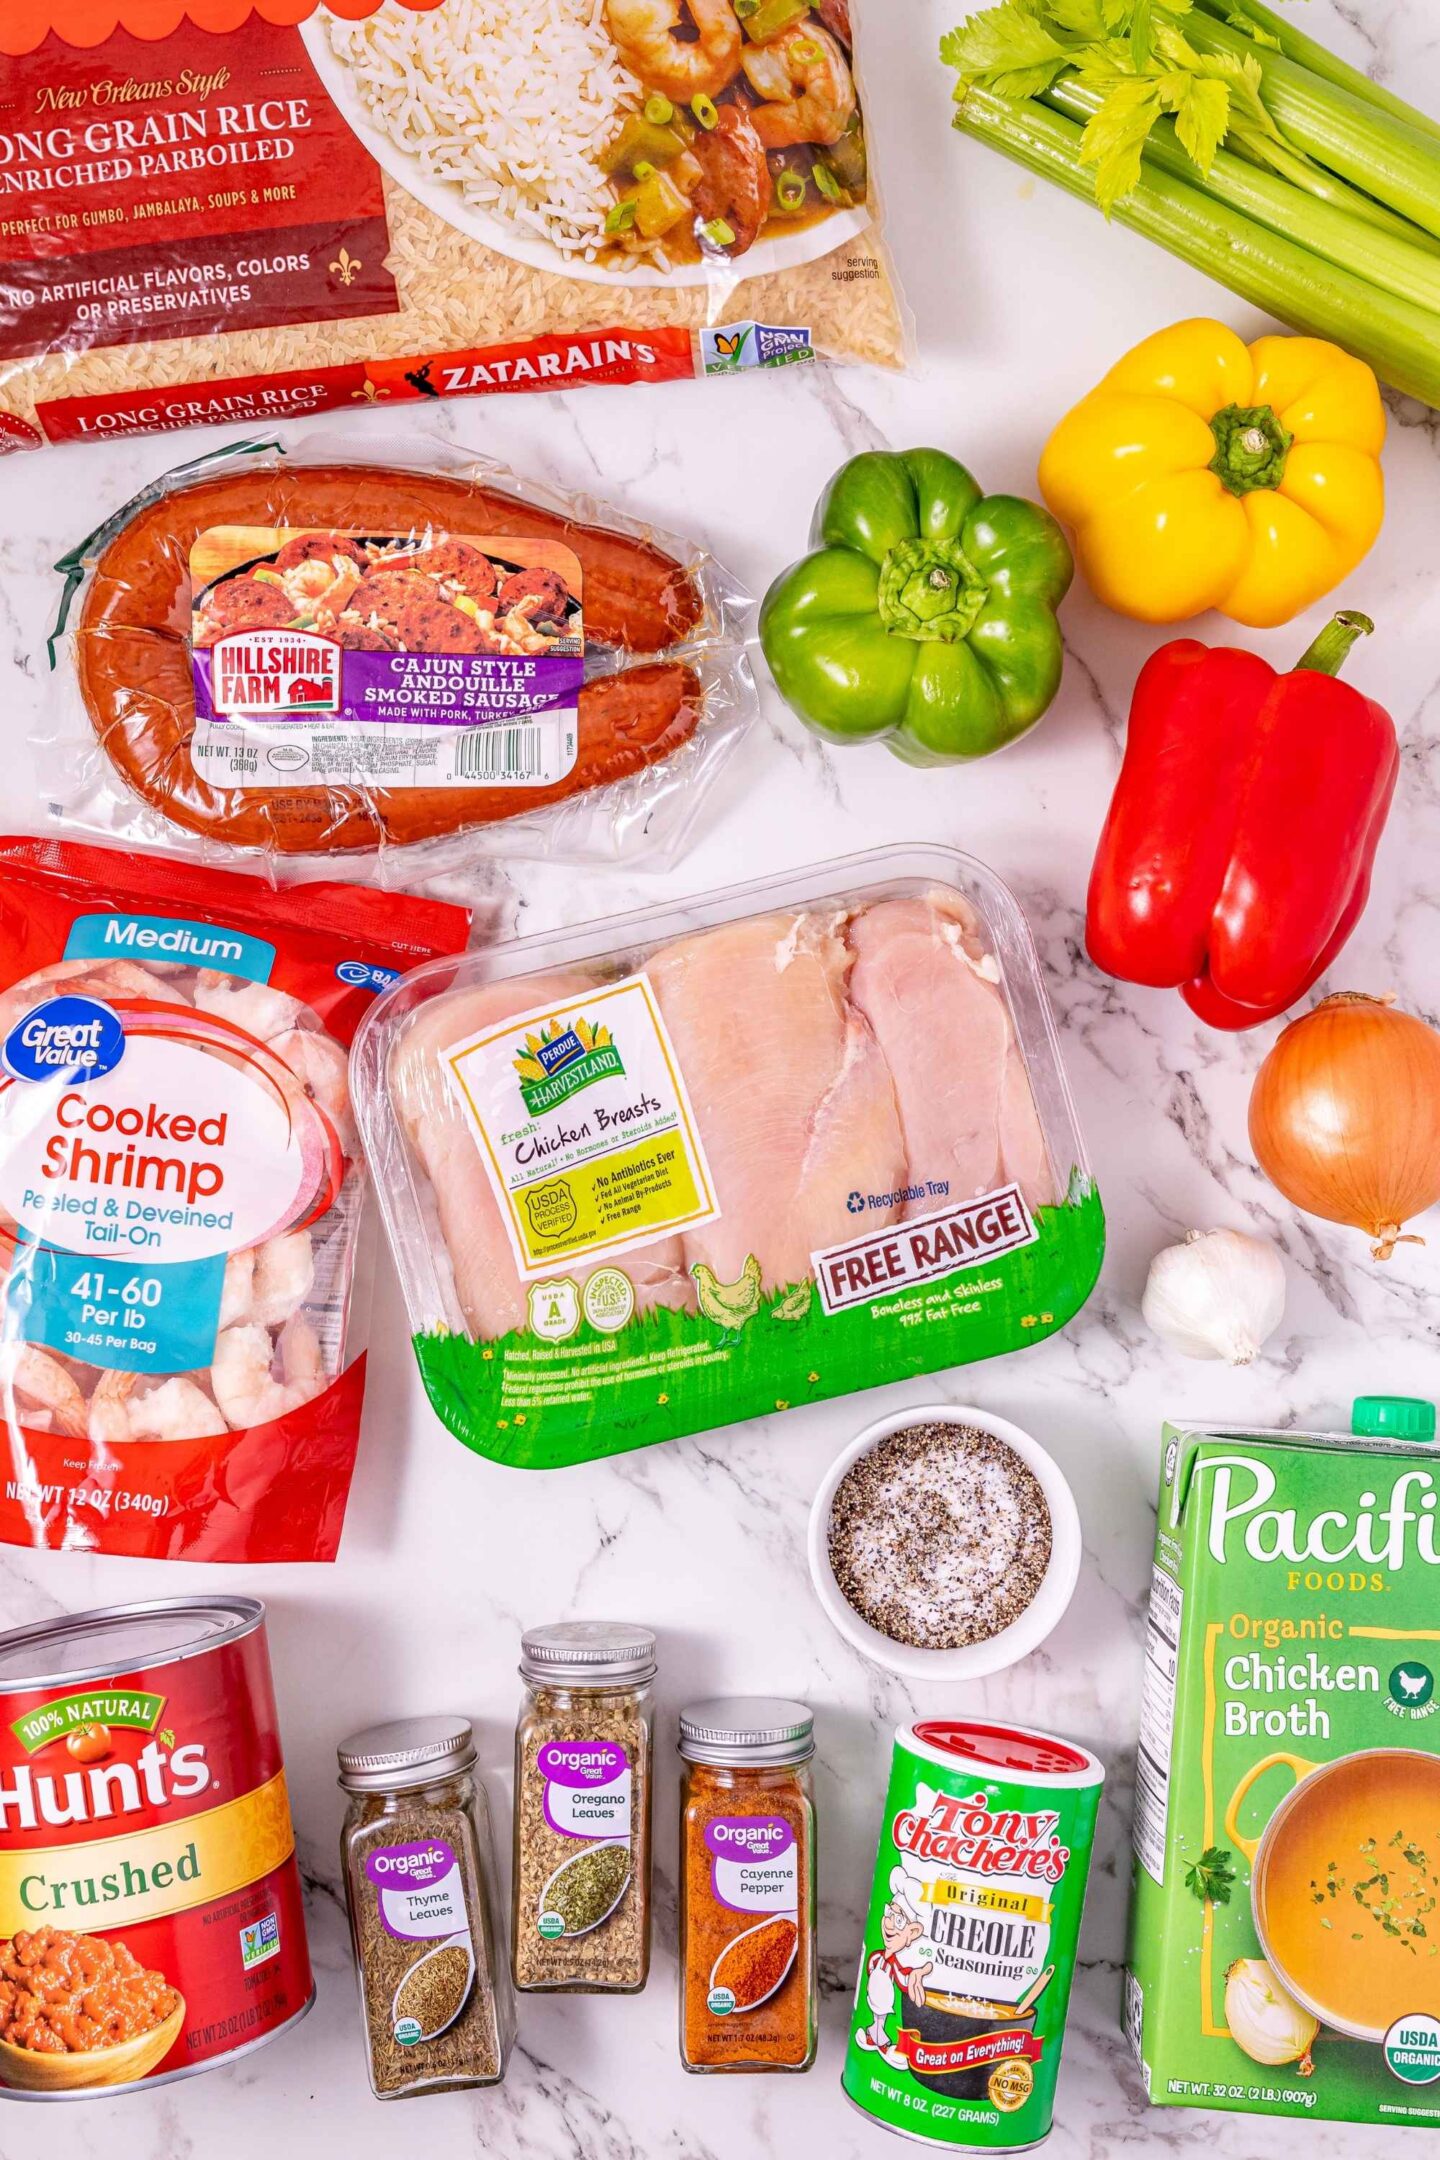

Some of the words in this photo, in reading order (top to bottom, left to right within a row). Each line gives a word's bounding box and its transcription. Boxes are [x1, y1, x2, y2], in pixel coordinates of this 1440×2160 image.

[35, 87, 88, 114] New
[89, 76, 173, 107] Orleans
[175, 65, 231, 100] Style
[84, 108, 216, 155] GRAIN
[219, 98, 312, 134] RICE
[139, 137, 295, 177] PARBOILED
[1, 215, 52, 237] PERFECT
[56, 214, 79, 231] FOR
[82, 207, 129, 227] GUMBO,
[132, 196, 205, 220] JAMBALAYA,
[208, 187, 247, 210] SOUPS
[250, 188, 260, 204] &
[263, 184, 297, 202] MORE
[831, 266, 881, 283] suggestion
[846, 256, 879, 271] serving
[8, 289, 36, 308] NO
[40, 273, 140, 305] ARTIFICIAL
[143, 262, 232, 291] FLAVORS,
[236, 253, 311, 278] COLORS
[76, 302, 104, 322] OR
[107, 284, 252, 316] PRESERVATIVES
[442, 340, 656, 391] ZATARAIN'S
[78, 407, 158, 432] LONG
[165, 394, 257, 419] GRAIN
[258, 384, 328, 404] RICE
[253, 636, 276, 645] EST
[221, 647, 334, 675] HILLSHIRE
[390, 657, 465, 676] CAJUN
[469, 660, 536, 678] STYLE
[222, 674, 281, 704] FARM
[401, 674, 525, 694] ANDOUILLE
[364, 687, 457, 707] SMOKED
[462, 691, 560, 709] SAUSAGE
[377, 705, 405, 718] MADE
[407, 706, 438, 719] WITH
[440, 708, 472, 721] PORK,
[197, 745, 214, 757] NET
[216, 746, 231, 758] WT.
[234, 747, 245, 758] 13
[247, 748, 258, 758] OZ
[230, 759, 258, 772] (368g)
[465, 772, 496, 780] 44500
[501, 772, 531, 780] 34167
[104, 919, 242, 961] Medium
[21, 1018, 102, 1049] Great
[541, 1036, 577, 1065] PERDUE
[533, 1052, 618, 1107] HARVESTLAND
[56, 1093, 228, 1146] Cooked
[515, 1123, 591, 1164] Chicken
[594, 1093, 662, 1130] Breasts
[501, 1122, 541, 1145] fresh:
[42, 1136, 224, 1204] Shrimp
[596, 1175, 608, 1188] No
[611, 1159, 656, 1183] Antibiotics
[658, 1150, 675, 1164] Ever
[601, 1189, 612, 1199] Fed
[622, 1174, 655, 1193] Vegetarian
[656, 1167, 669, 1178] Diet
[604, 1202, 612, 1210] No
[613, 1195, 635, 1208] Animal
[636, 1180, 671, 1200] By-Products
[868, 1183, 926, 1209] Recyclable
[926, 1180, 949, 1196] Tray
[22, 1190, 98, 1216] Peeled
[104, 1199, 119, 1217] &
[126, 1201, 233, 1230] Deveined
[531, 1188, 568, 1210] USDA
[535, 1202, 570, 1220] PROCESS
[607, 1211, 620, 1221] Free
[622, 1204, 641, 1218] Range
[84, 1221, 161, 1247] Tail-On
[538, 1214, 572, 1231] VERIFIED
[828, 1244, 907, 1297] FREE
[910, 1203, 1020, 1269] RANGE
[71, 1273, 163, 1307] 41-60
[871, 1297, 923, 1318] Boneless
[926, 1290, 951, 1305] and
[954, 1278, 1003, 1297] Skinless
[81, 1304, 117, 1327] Per
[123, 1310, 146, 1328] lb
[549, 1301, 560, 1318] A
[900, 1311, 923, 1326] 99%
[926, 1308, 947, 1321] Fat
[950, 1301, 981, 1315] Free
[64, 1332, 103, 1347] 30-45
[106, 1336, 127, 1349] Per
[130, 1339, 156, 1353] Bag
[63, 1459, 86, 1472] Keep
[89, 1460, 119, 1472] Frozen
[6, 1481, 37, 1502] NE
[39, 1486, 64, 1504] WT
[69, 1488, 88, 1506] 12
[91, 1490, 110, 1508] OZ
[114, 1491, 169, 1517] (340g)
[1191, 1456, 1440, 1571] Pacifi
[1287, 1572, 1384, 1592] FOODS
[1229, 1613, 1343, 1648] Organic
[1224, 1652, 1380, 1693] Chicken
[22, 1711, 64, 1741] 100%
[66, 1698, 152, 1722] NATURAL
[1224, 1698, 1330, 1738] Broth
[1383, 1697, 1406, 1718] FREE
[1410, 1699, 1440, 1719] RANGE
[547, 1748, 617, 1771] Organic
[571, 1794, 626, 1808] Oregano
[571, 1808, 615, 1819] Leaves
[932, 1792, 1059, 1850] Tony
[713, 1824, 784, 1846] Organic
[893, 1812, 1070, 1880] Chachere's
[374, 1848, 445, 1876] Organic
[20, 1843, 202, 1911] Crushed
[740, 1869, 793, 1883] Cayenne
[406, 1891, 450, 1908] Thyme
[740, 1883, 784, 1898] Pepper
[947, 1885, 1029, 1912] Original
[261, 1917, 275, 1931] NON
[409, 1904, 453, 1922] Leaves
[261, 1924, 276, 1938] GMO
[930, 1909, 1036, 1959] CREOLE
[934, 1947, 1024, 1981] Seasoning
[186, 2028, 202, 2050] NET
[203, 2023, 216, 2046] WT
[399, 2022, 416, 2032] USDA
[1400, 2031, 1438, 2047] USDA
[915, 2048, 947, 2066] Great
[950, 2054, 963, 2064] on
[966, 2034, 1025, 2062] Everything!
[1393, 2051, 1440, 2066] ORGANIC
[993, 2077, 1009, 2089] NO
[1009, 2080, 1032, 2093] MSG
[1168, 2079, 1187, 2094] NET
[1190, 2081, 1211, 2097] WT.
[1213, 2083, 1227, 2096] 32
[1228, 2085, 1246, 2099] OZ.
[1248, 2086, 1259, 2101] (2
[1261, 2087, 1281, 2103] LB.)
[1282, 2089, 1318, 2108] (907g)
[870, 2077, 886, 2093] NET
[887, 2087, 902, 2103] WT
[903, 2094, 910, 2107] 8
[912, 2097, 928, 2113] OZ.
[931, 2103, 954, 2119] (227
[958, 2109, 1000, 2126] GRAMS)
[1379, 2103, 1407, 2115] SERVING
